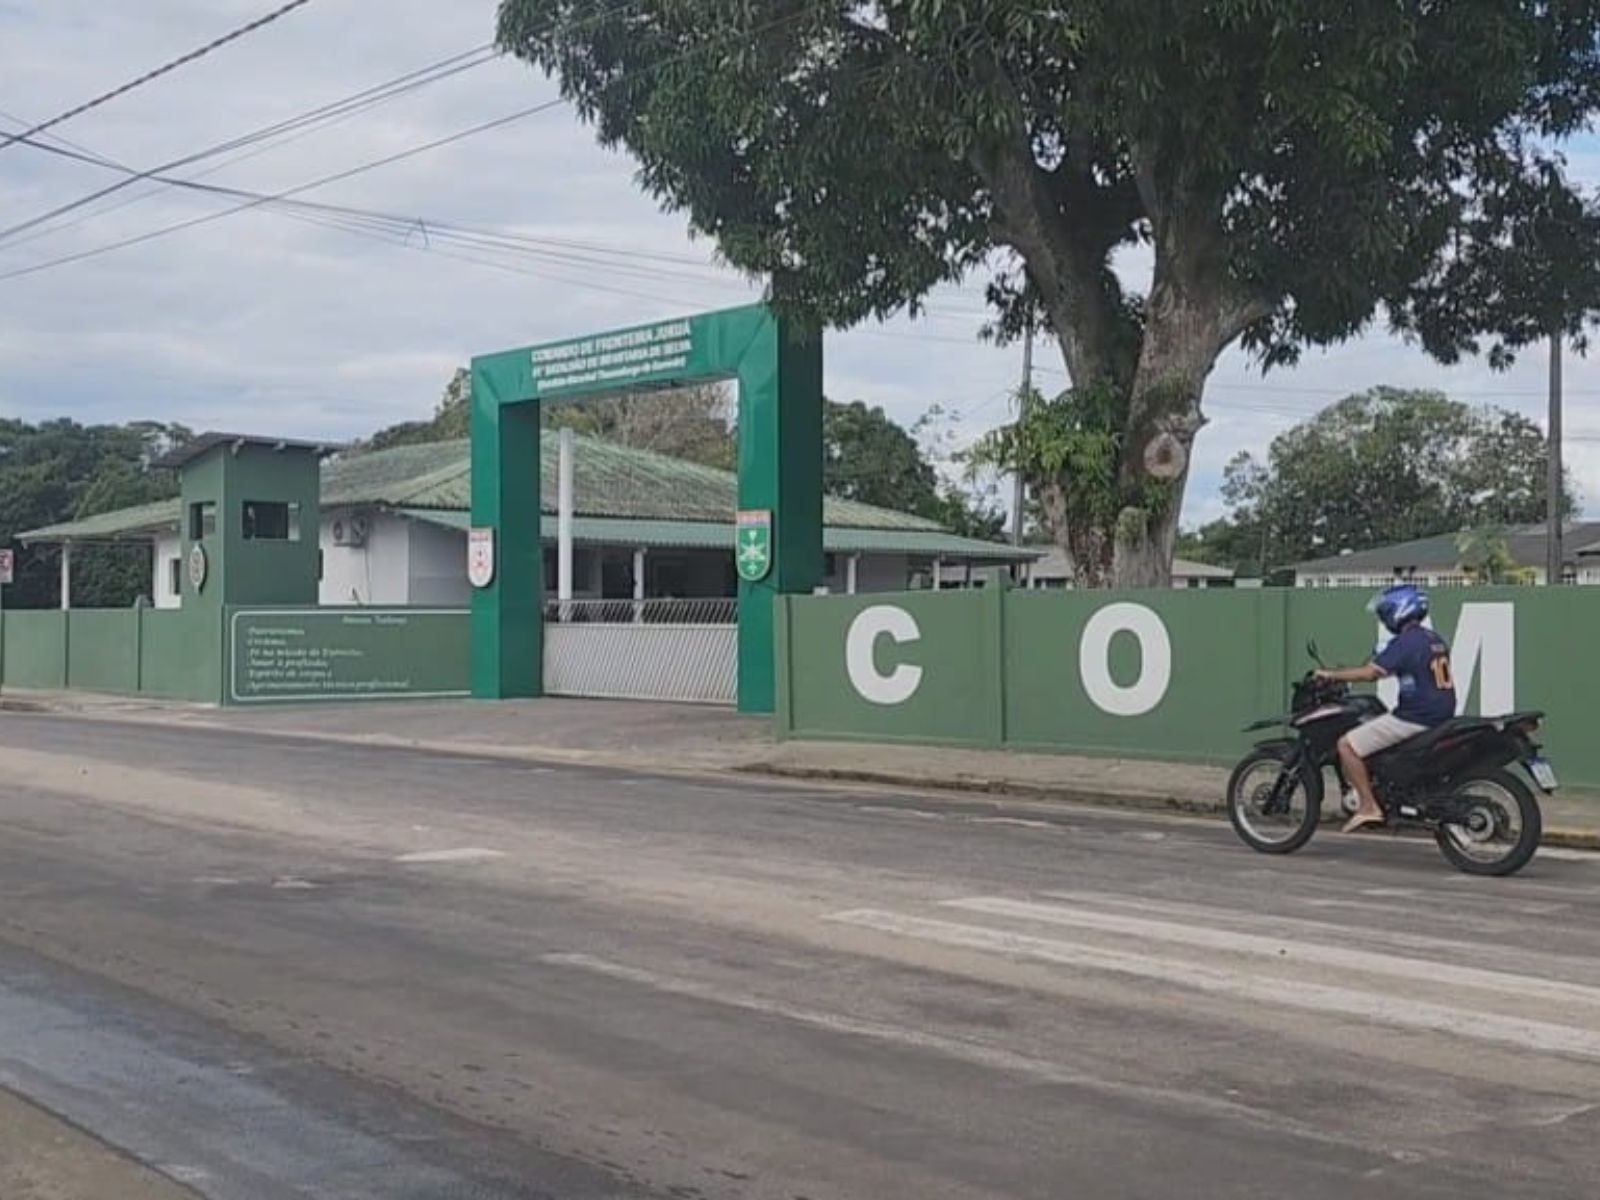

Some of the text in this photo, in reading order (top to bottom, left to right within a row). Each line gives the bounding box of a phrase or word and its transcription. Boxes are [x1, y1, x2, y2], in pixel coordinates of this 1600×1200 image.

[846, 605, 923, 704] C
[1079, 602, 1171, 716] O
[1430, 656, 1453, 690] 10
